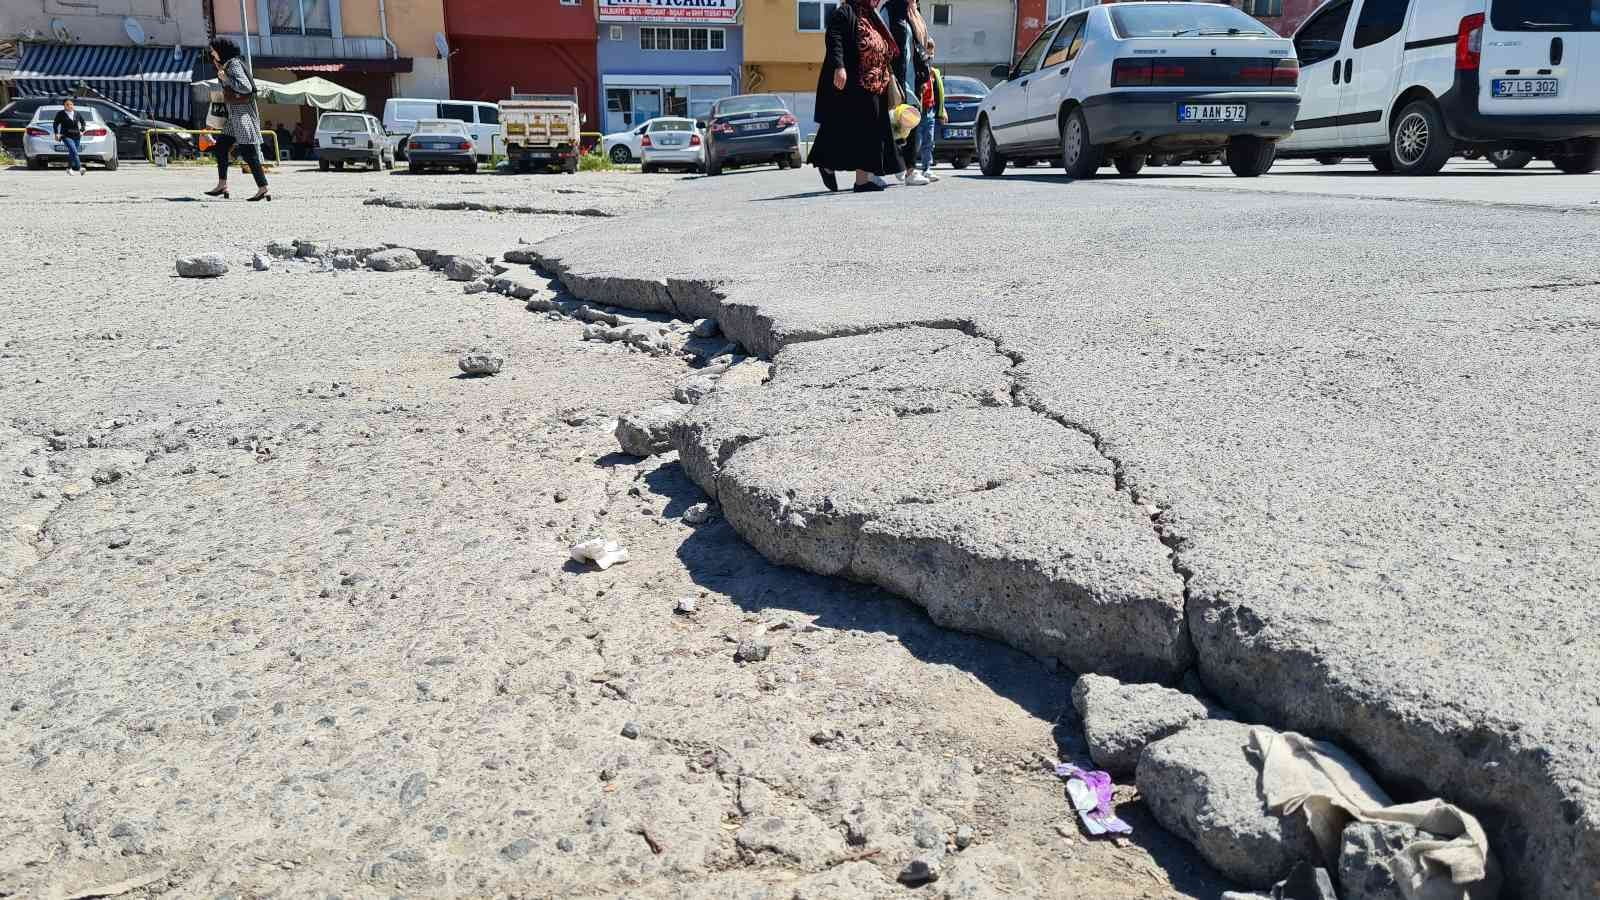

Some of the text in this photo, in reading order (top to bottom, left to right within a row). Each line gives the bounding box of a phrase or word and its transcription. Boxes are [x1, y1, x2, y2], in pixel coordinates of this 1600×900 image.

[1500, 81, 1556, 92] 67 LB 302
[1186, 106, 1245, 119] 67 AAN 572
